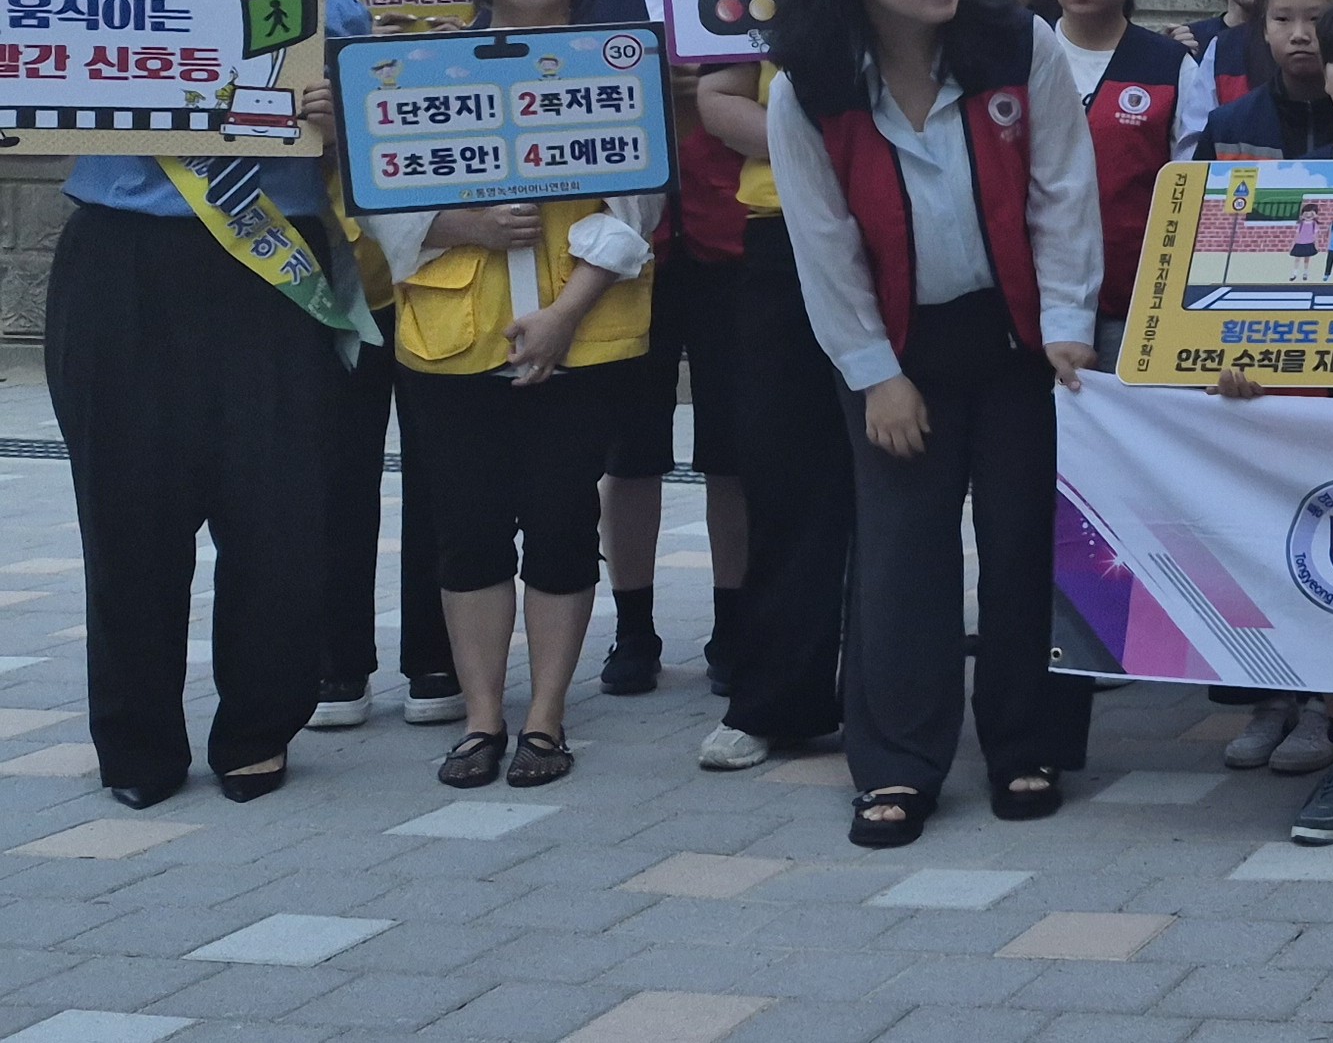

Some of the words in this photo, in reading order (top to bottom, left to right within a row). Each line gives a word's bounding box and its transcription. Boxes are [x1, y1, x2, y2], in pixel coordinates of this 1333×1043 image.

[84, 46, 222, 83] 신호등
[608, 43, 637, 60] 30
[376, 94, 496, 126] 1단정지!
[518, 85, 635, 117] 2쪽저쪽!
[380, 145, 501, 178] 3초동안!
[523, 136, 640, 168] 4고예방!
[1220, 319, 1320, 344] 횡단보도
[1174, 348, 1226, 372] 안전
[1231, 348, 1306, 373] 수칙을
